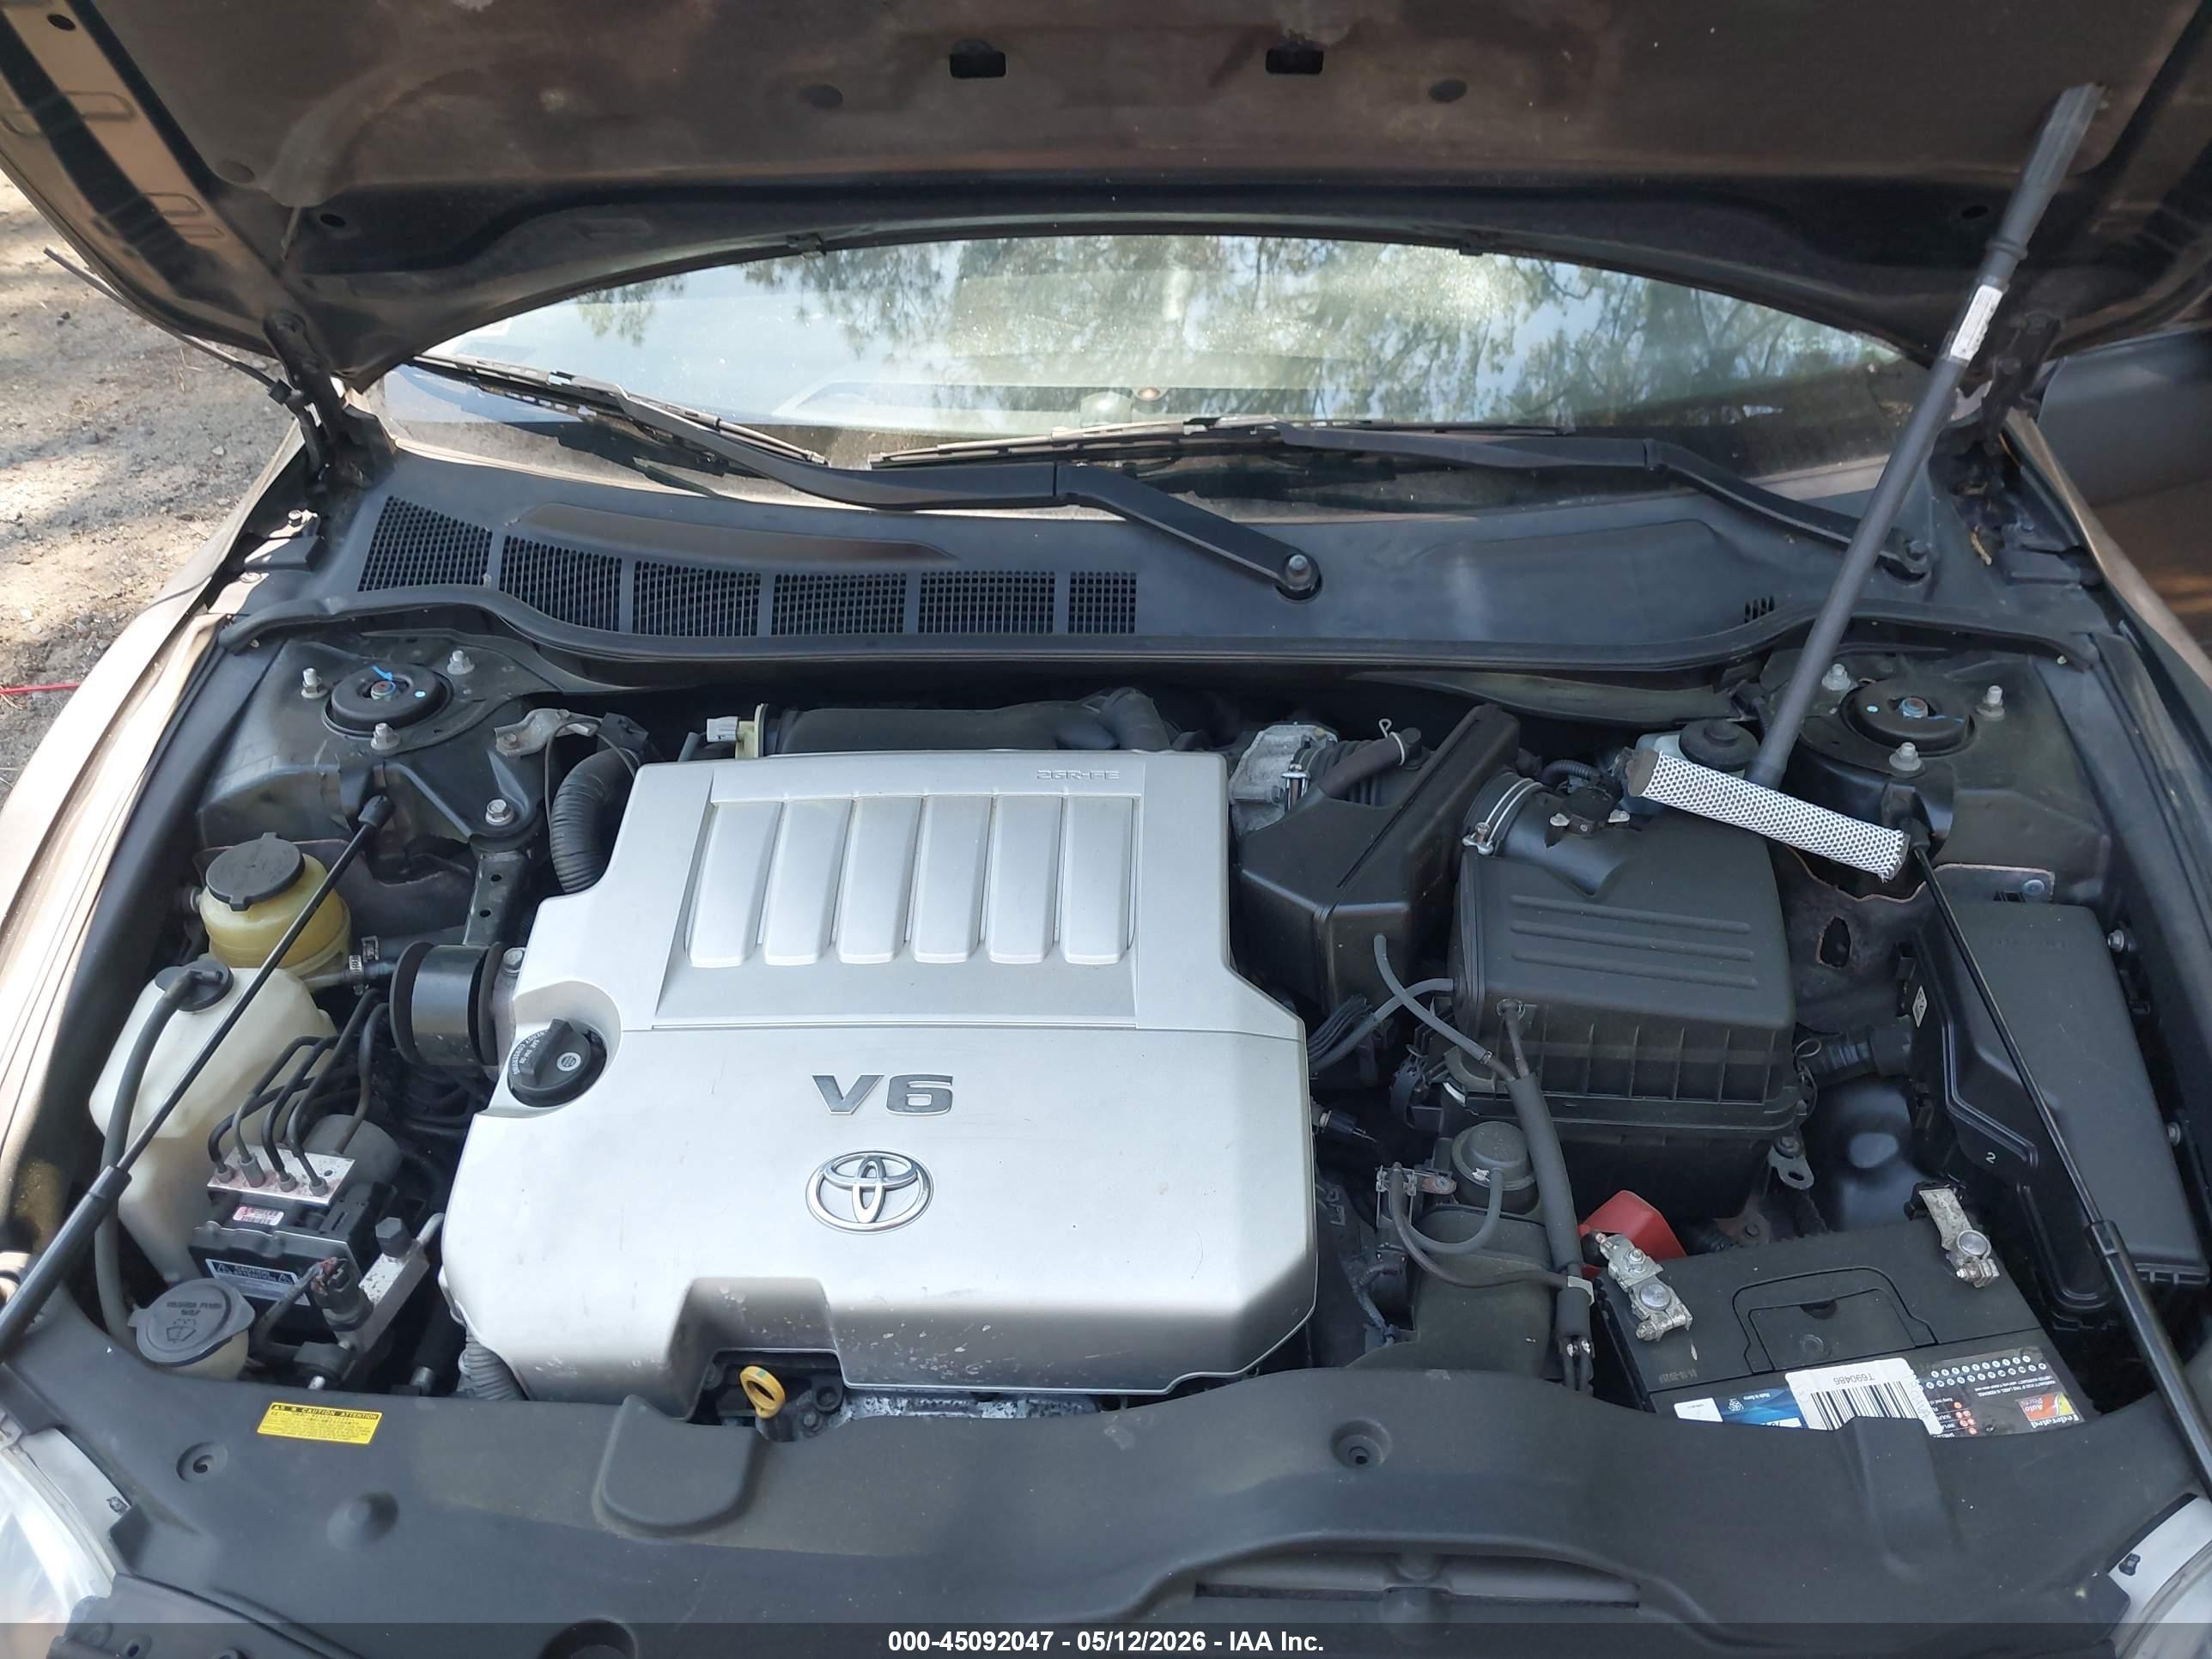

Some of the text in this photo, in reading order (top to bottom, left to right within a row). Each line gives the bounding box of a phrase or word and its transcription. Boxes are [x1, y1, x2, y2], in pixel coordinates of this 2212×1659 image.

[811, 1073, 954, 1116] V6
[1833, 1373, 1875, 1385] T690486
[2030, 1414, 2080, 1429] Federated
